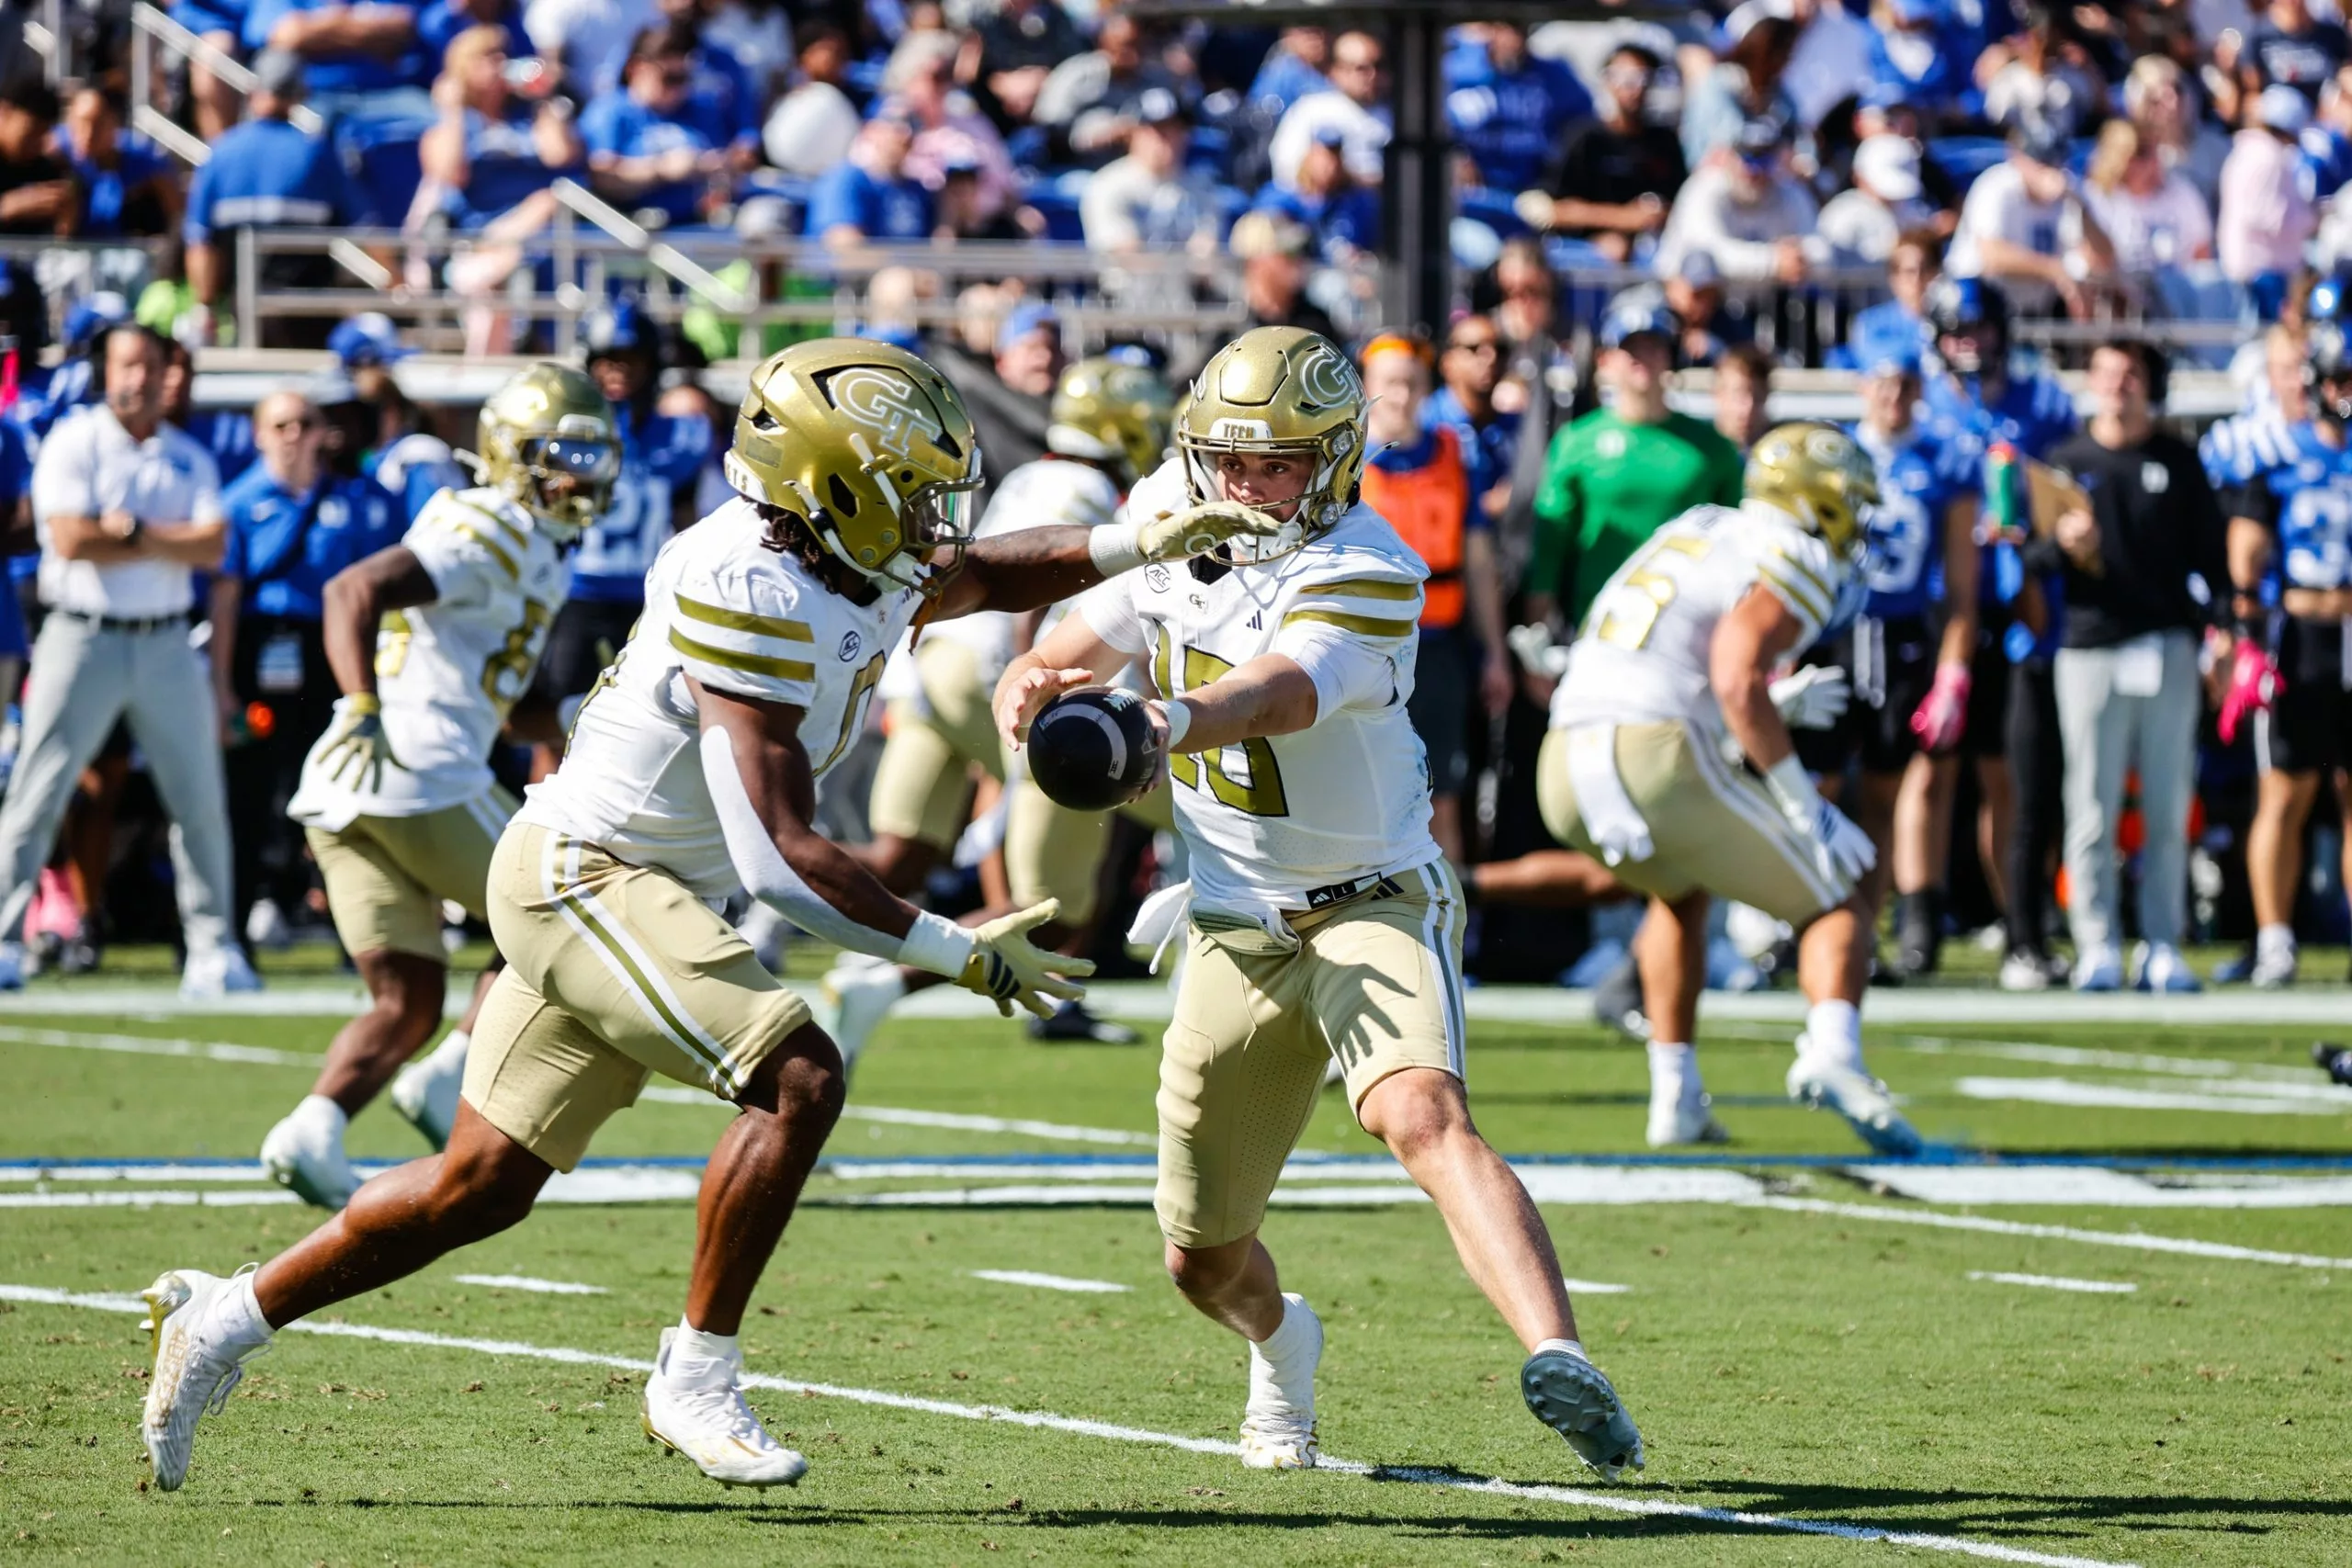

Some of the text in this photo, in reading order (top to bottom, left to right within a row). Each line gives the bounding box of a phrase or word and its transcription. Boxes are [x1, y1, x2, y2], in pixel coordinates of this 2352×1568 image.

[830, 367, 944, 457] GT
[1223, 423, 1255, 439] TECH
[1148, 569, 1172, 586] ACC
